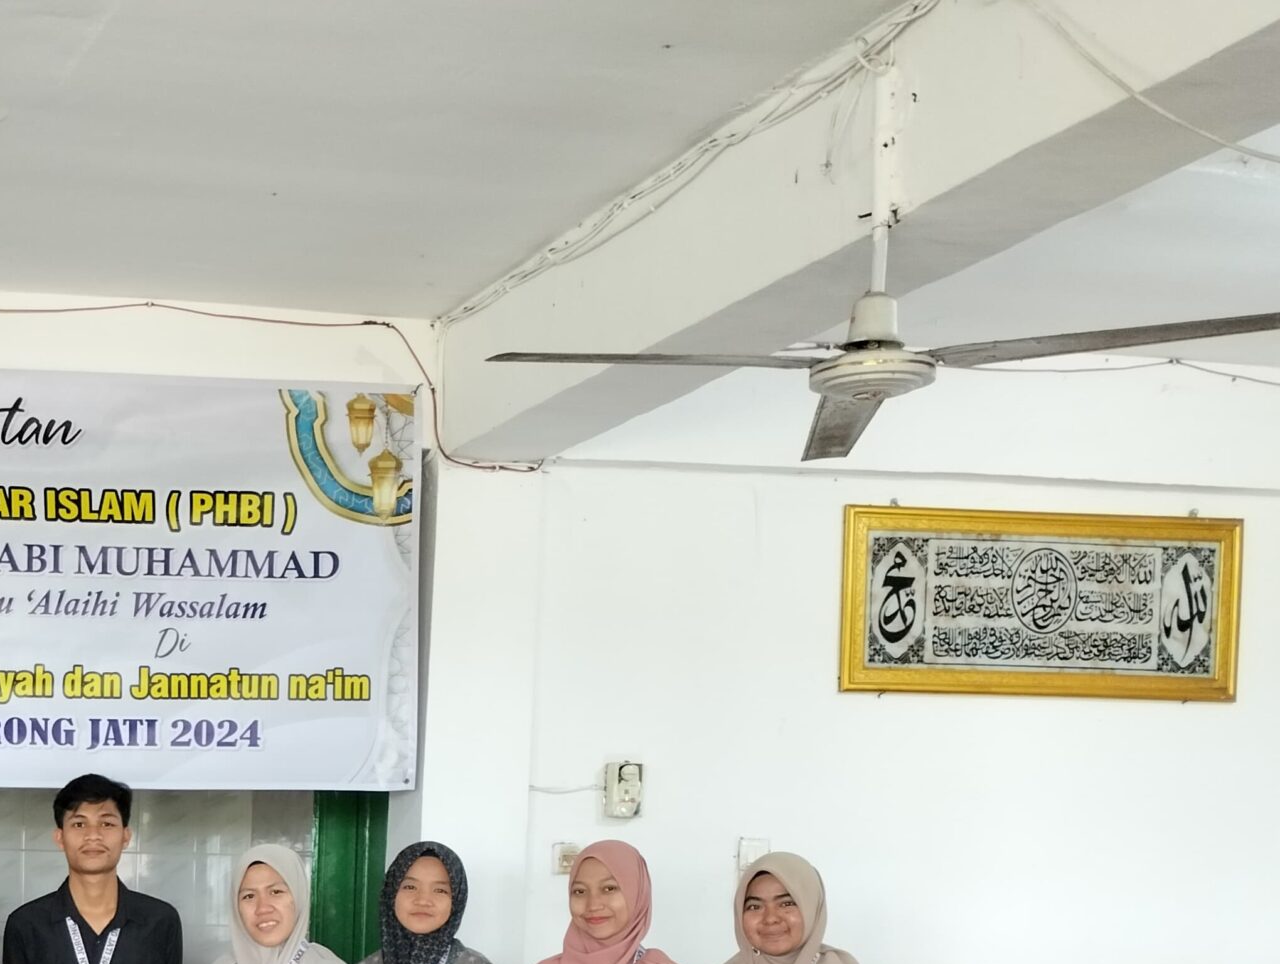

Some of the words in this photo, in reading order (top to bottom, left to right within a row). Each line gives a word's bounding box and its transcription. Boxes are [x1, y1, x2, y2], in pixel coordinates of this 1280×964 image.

[44, 486, 155, 524] ISLAM
[189, 491, 275, 527] PHBI
[74, 545, 340, 580] MUHAMMAD
[132, 591, 268, 620] Wassalam
[154, 627, 192, 659] Di
[63, 665, 122, 699] dan
[130, 666, 279, 700] Jannatun
[288, 667, 371, 700] na'im
[86, 718, 158, 750] JATI
[171, 719, 261, 748] 2024
